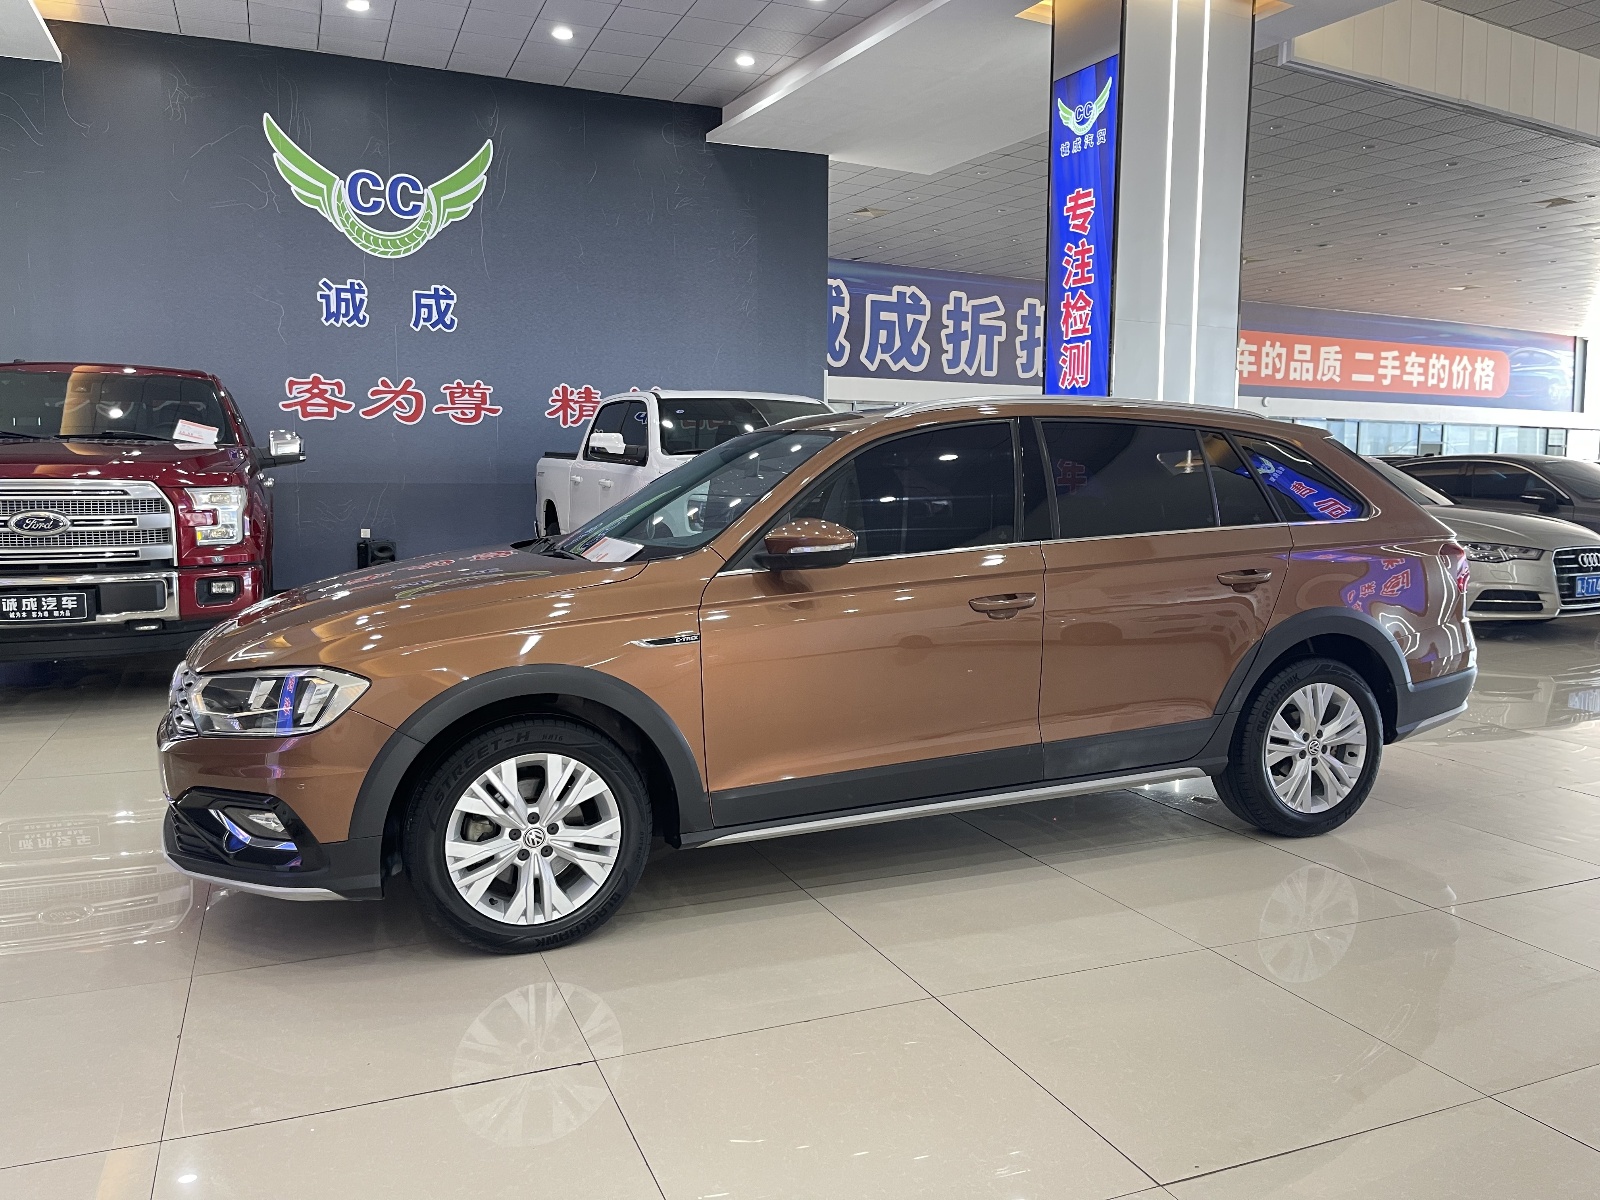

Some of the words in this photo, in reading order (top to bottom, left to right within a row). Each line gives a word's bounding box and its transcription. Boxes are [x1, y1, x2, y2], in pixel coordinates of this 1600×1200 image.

[1075, 101, 1093, 122] CC
[1060, 128, 1106, 157] 诚成汽贸
[346, 169, 424, 219] CC
[1059, 188, 1095, 389] 专注检测
[1351, 350, 1495, 391] 二手车的价格
[279, 373, 502, 425] 客为尊
[23, 518, 53, 530] Ford
[2, 596, 78, 612] 诚成汽车
[1257, 672, 1301, 733] BLACKHAWK
[437, 730, 531, 805] STREET-H
[533, 892, 623, 949] BLACKHAWK
